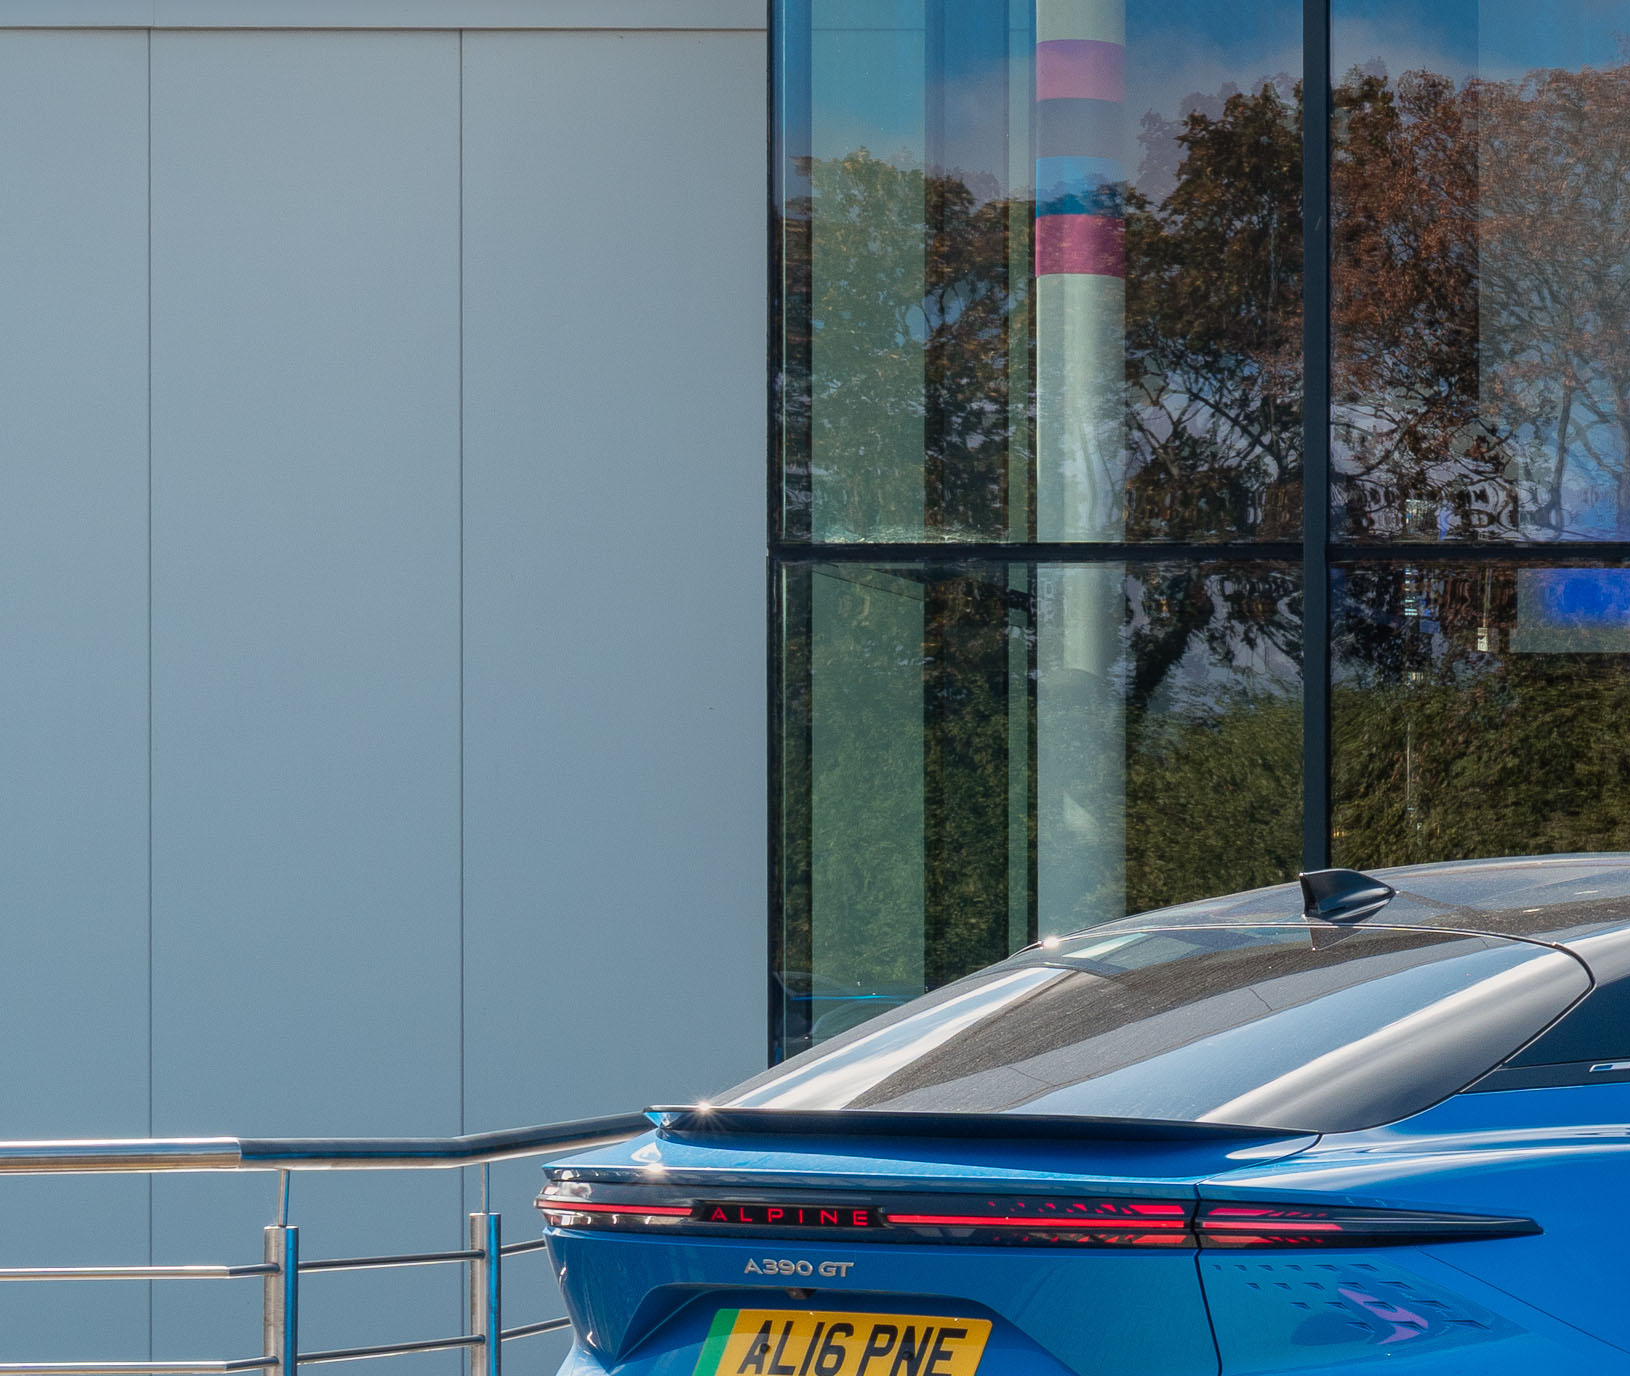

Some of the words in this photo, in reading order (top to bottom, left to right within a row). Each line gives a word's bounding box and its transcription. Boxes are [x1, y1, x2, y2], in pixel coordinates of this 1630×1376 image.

[711, 1207, 868, 1226] ALPINE
[744, 1258, 813, 1277] A390
[818, 1261, 855, 1277] GT
